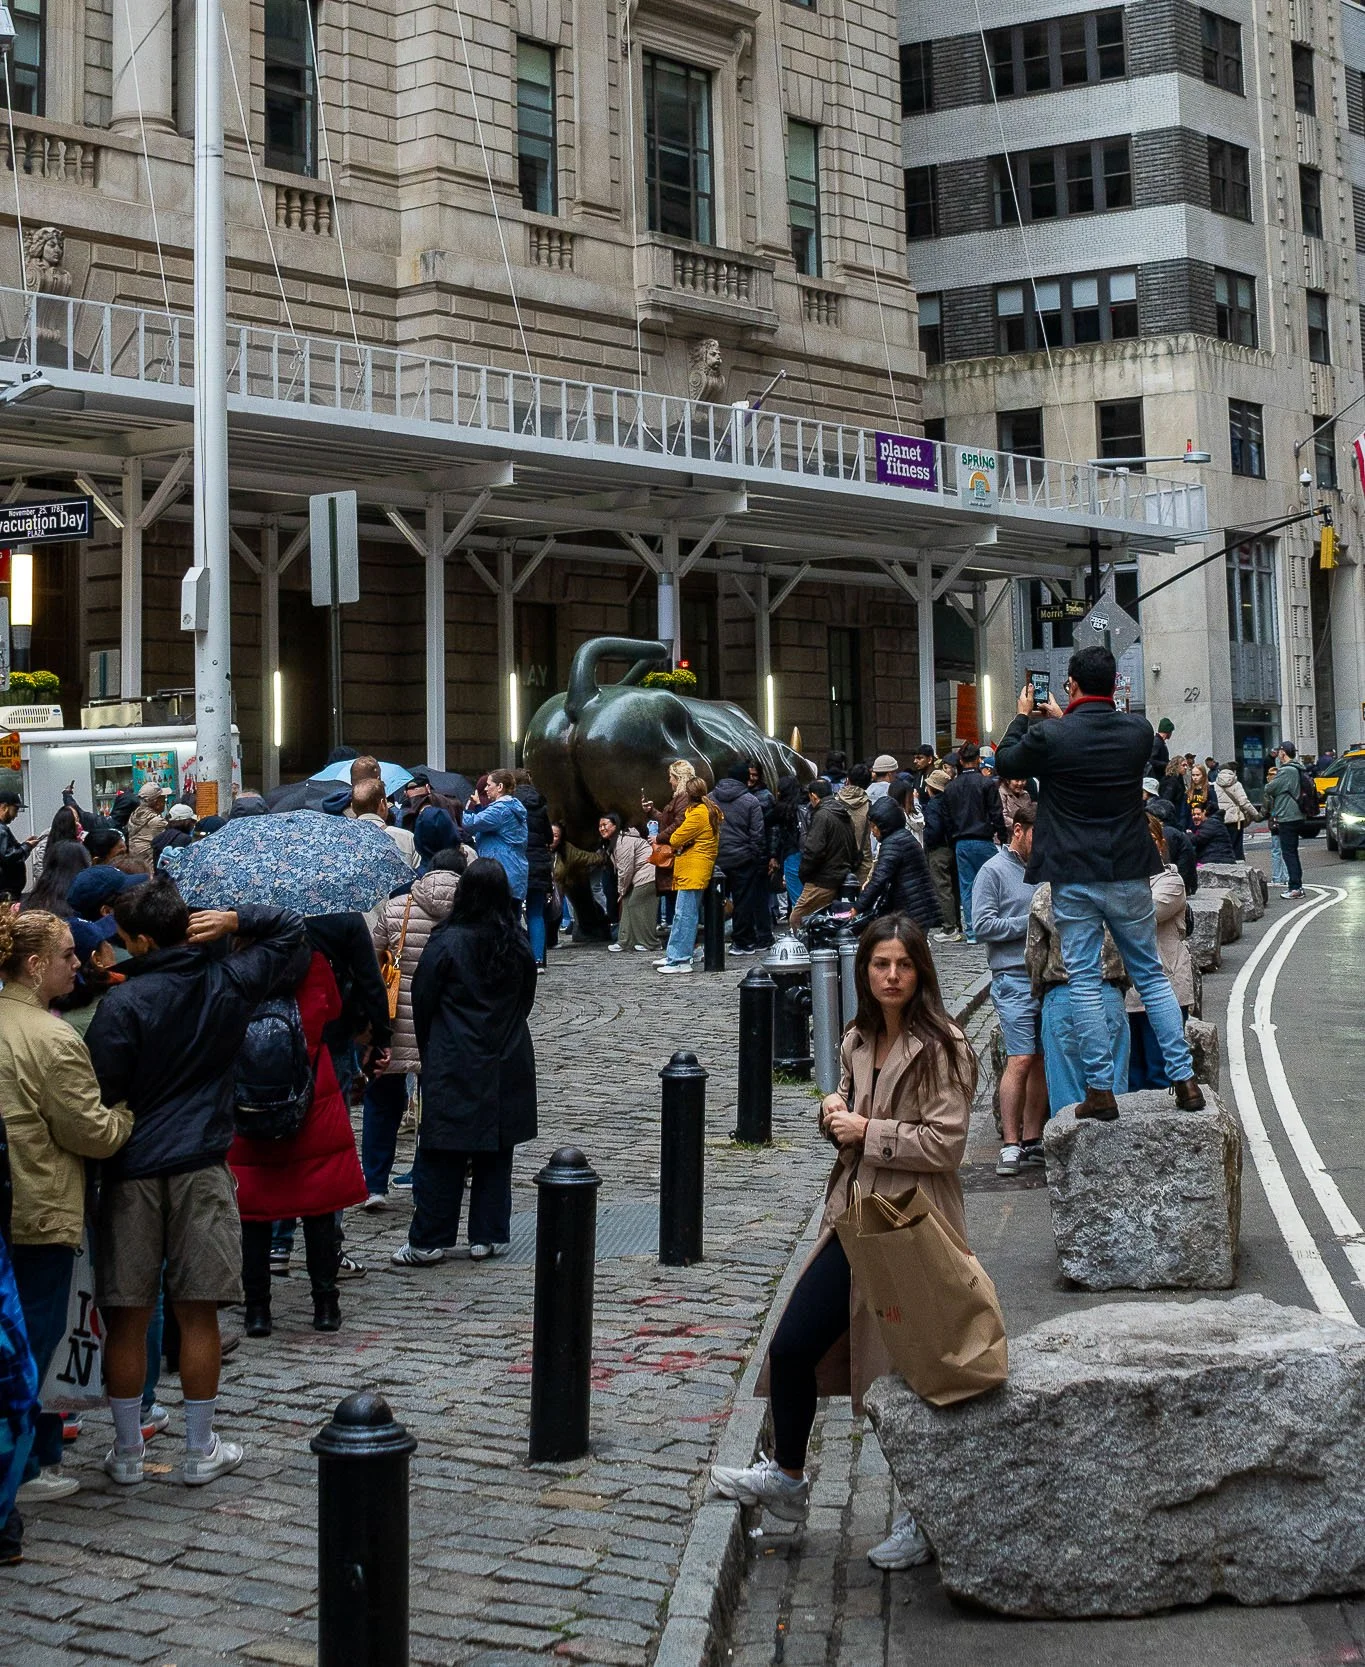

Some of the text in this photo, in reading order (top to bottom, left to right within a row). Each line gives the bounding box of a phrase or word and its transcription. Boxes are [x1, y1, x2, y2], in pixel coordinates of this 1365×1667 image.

[880, 439, 922, 461] planet
[961, 450, 995, 469] SPRING
[886, 457, 930, 480] fitness
[8, 508, 35, 517] November
[51, 505, 64, 513] 1783
[60, 511, 85, 531] Day
[27, 530, 45, 538] PLAZA
[1040, 609, 1064, 619] Morris
[1184, 687, 1200, 702] 29
[0, 744, 20, 758] LOW
